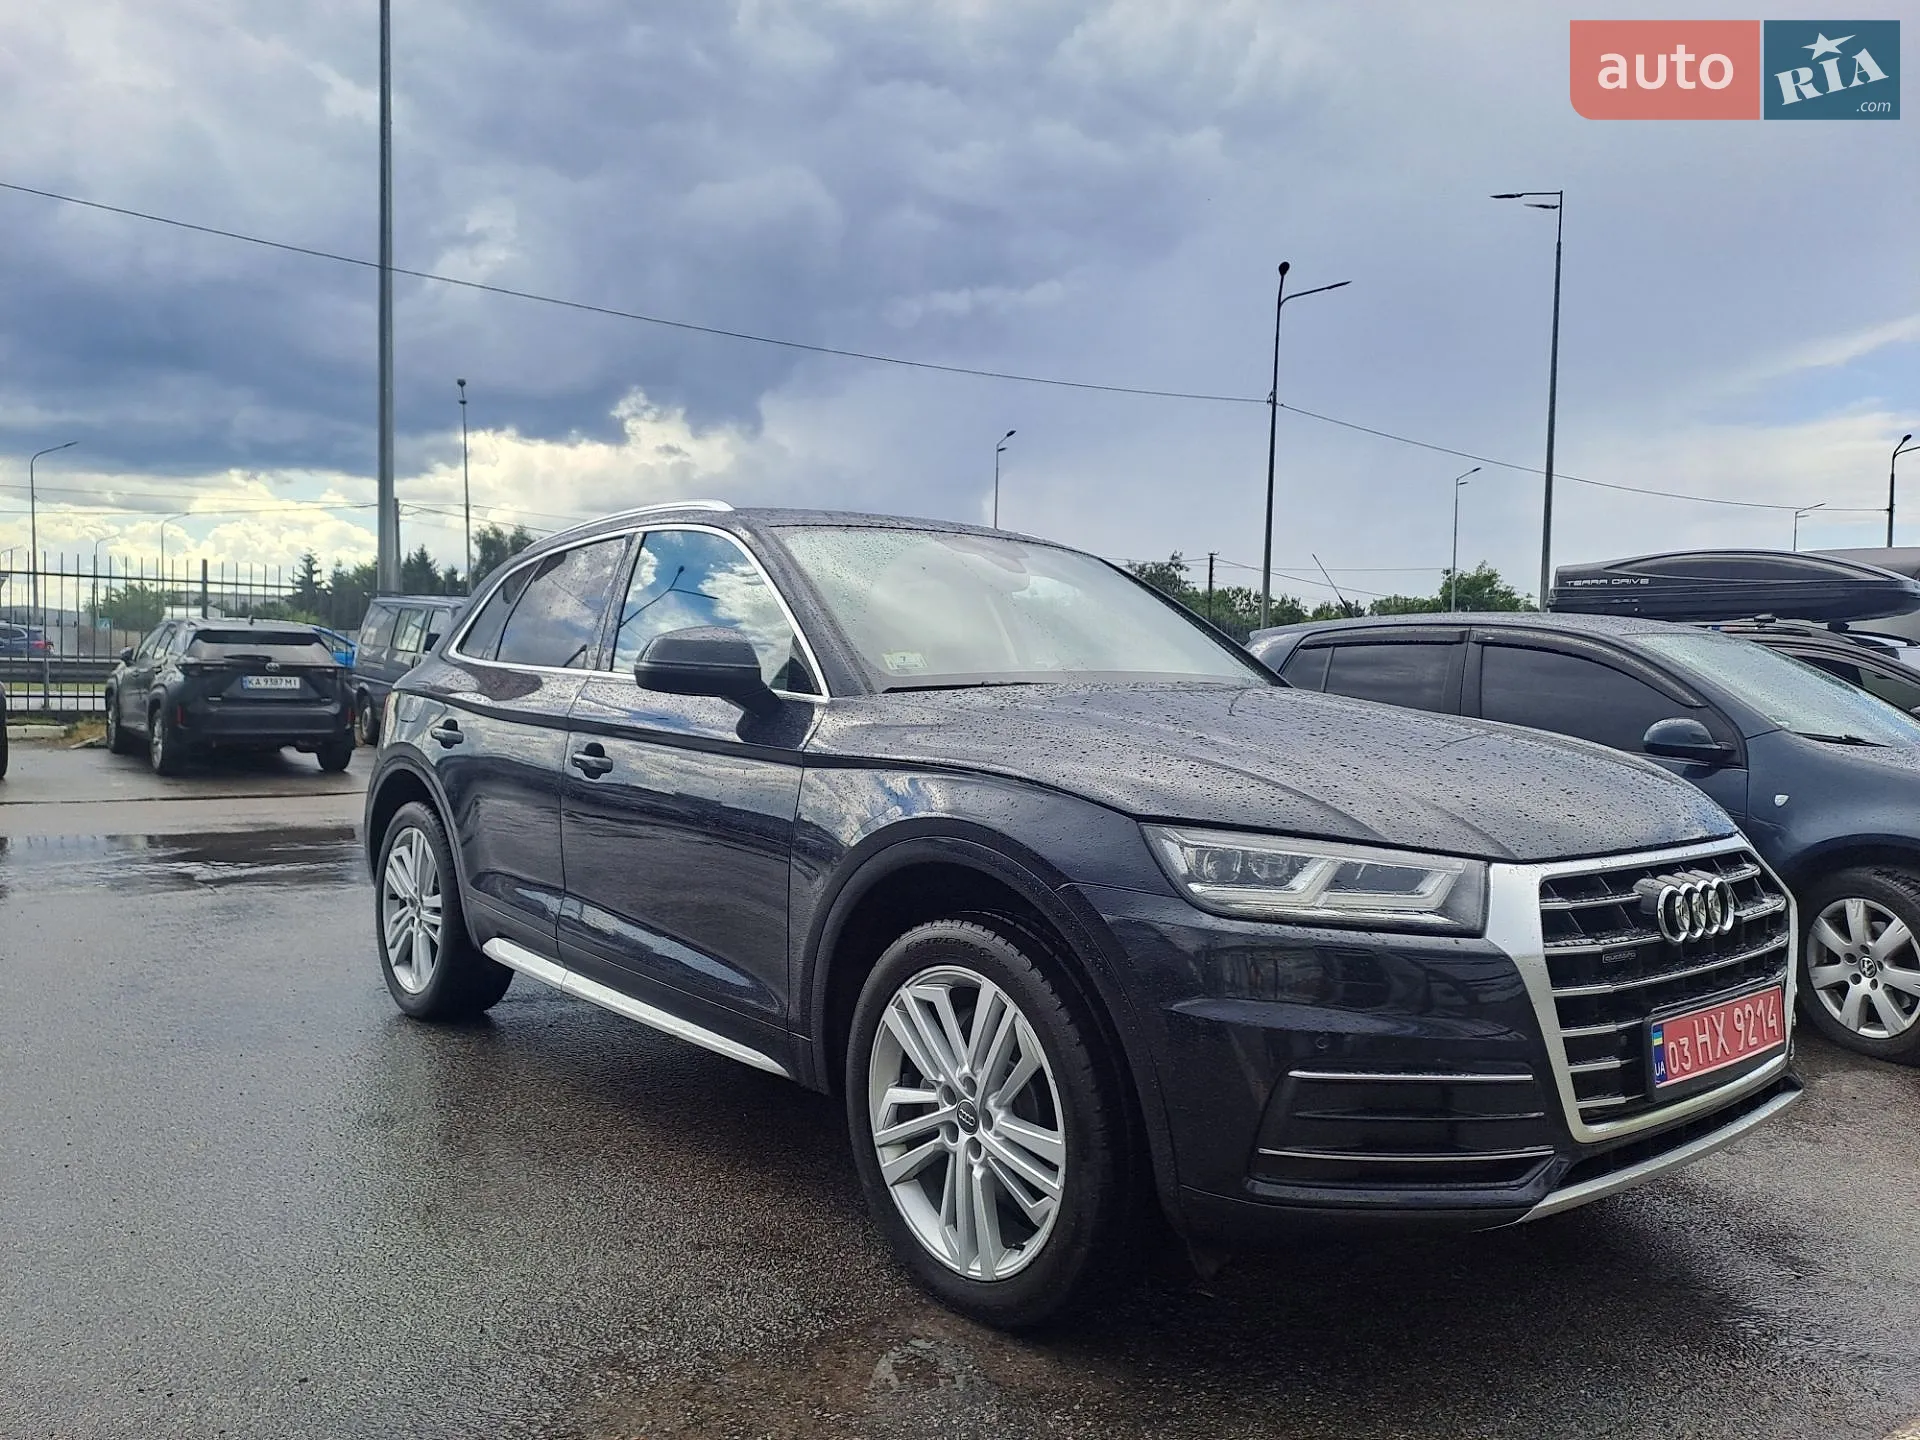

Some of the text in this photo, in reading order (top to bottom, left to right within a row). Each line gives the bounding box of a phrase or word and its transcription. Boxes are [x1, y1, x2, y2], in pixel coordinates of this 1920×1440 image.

[1565, 579, 1608, 587] TERRA
[1668, 995, 1779, 1075] 03 HX 9214
[1654, 1062, 1666, 1076] UA
